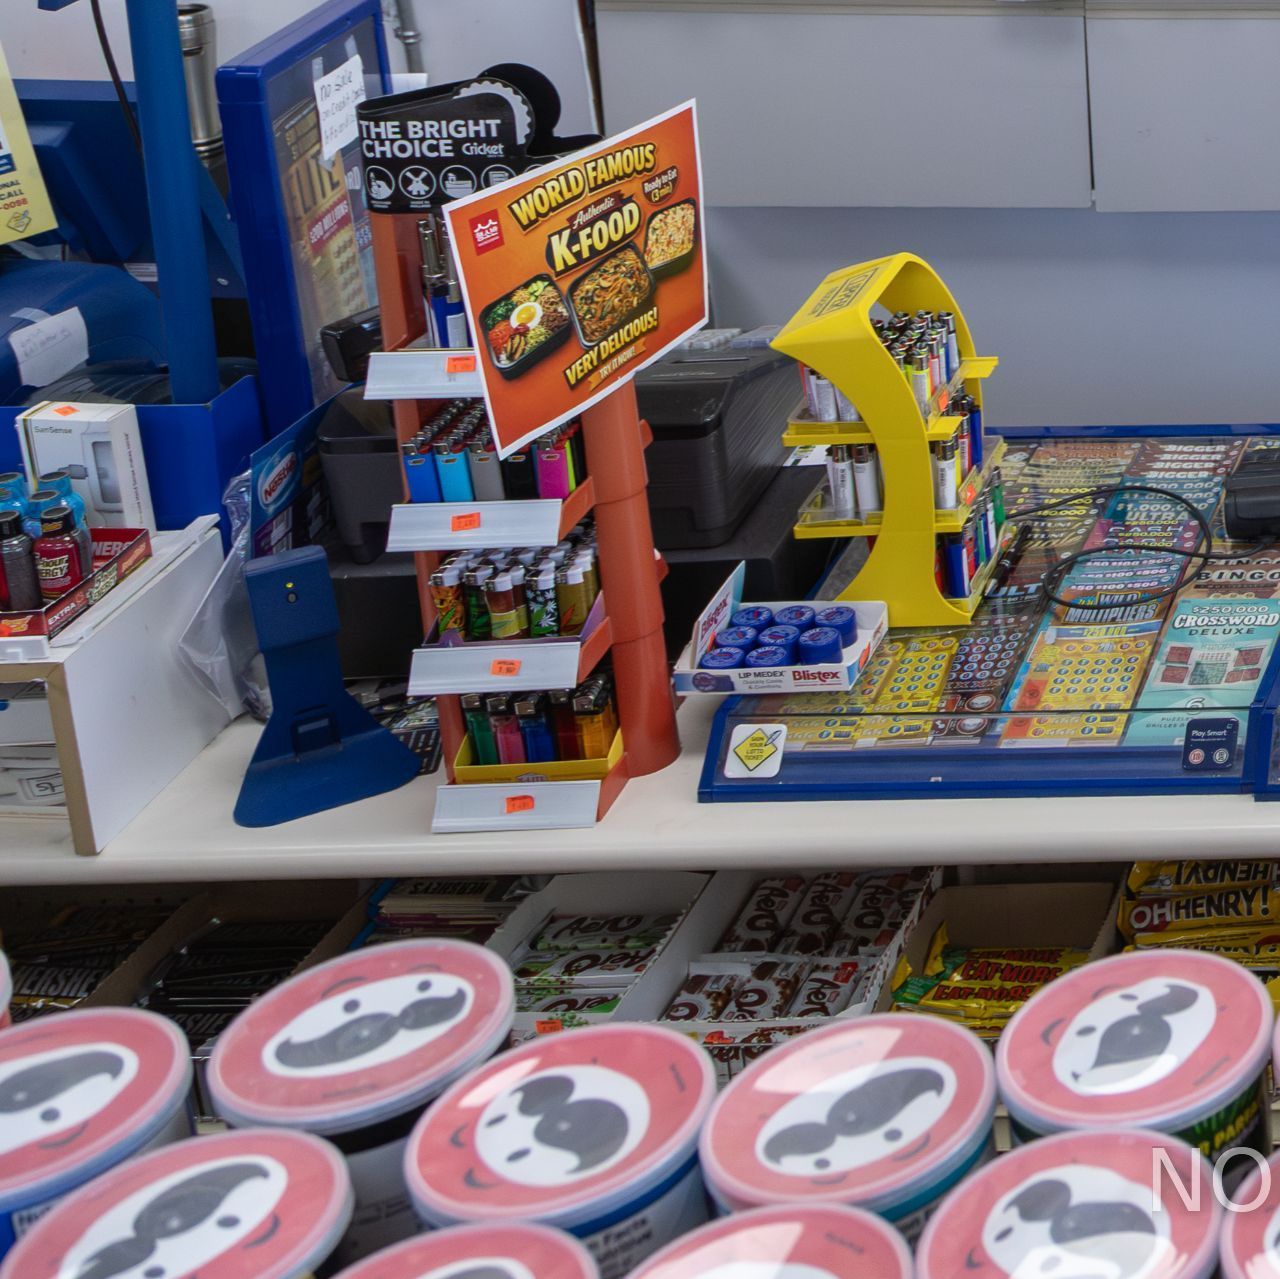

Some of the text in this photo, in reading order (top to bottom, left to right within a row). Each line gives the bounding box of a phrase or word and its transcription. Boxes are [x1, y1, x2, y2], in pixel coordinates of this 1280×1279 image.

[360, 120, 501, 139] THE BRIGHT
[362, 140, 454, 157] CHOICE
[462, 142, 503, 155] Cricket
[513, 144, 656, 225] WORLD FAMOUS
[550, 204, 640, 272] K-FOOD
[566, 307, 658, 385] VERY DELICIOUS!
[1174, 613, 1279, 628] CROSSWORD
[1189, 627, 1255, 635] DELUXE
[792, 670, 840, 681] Blistex
